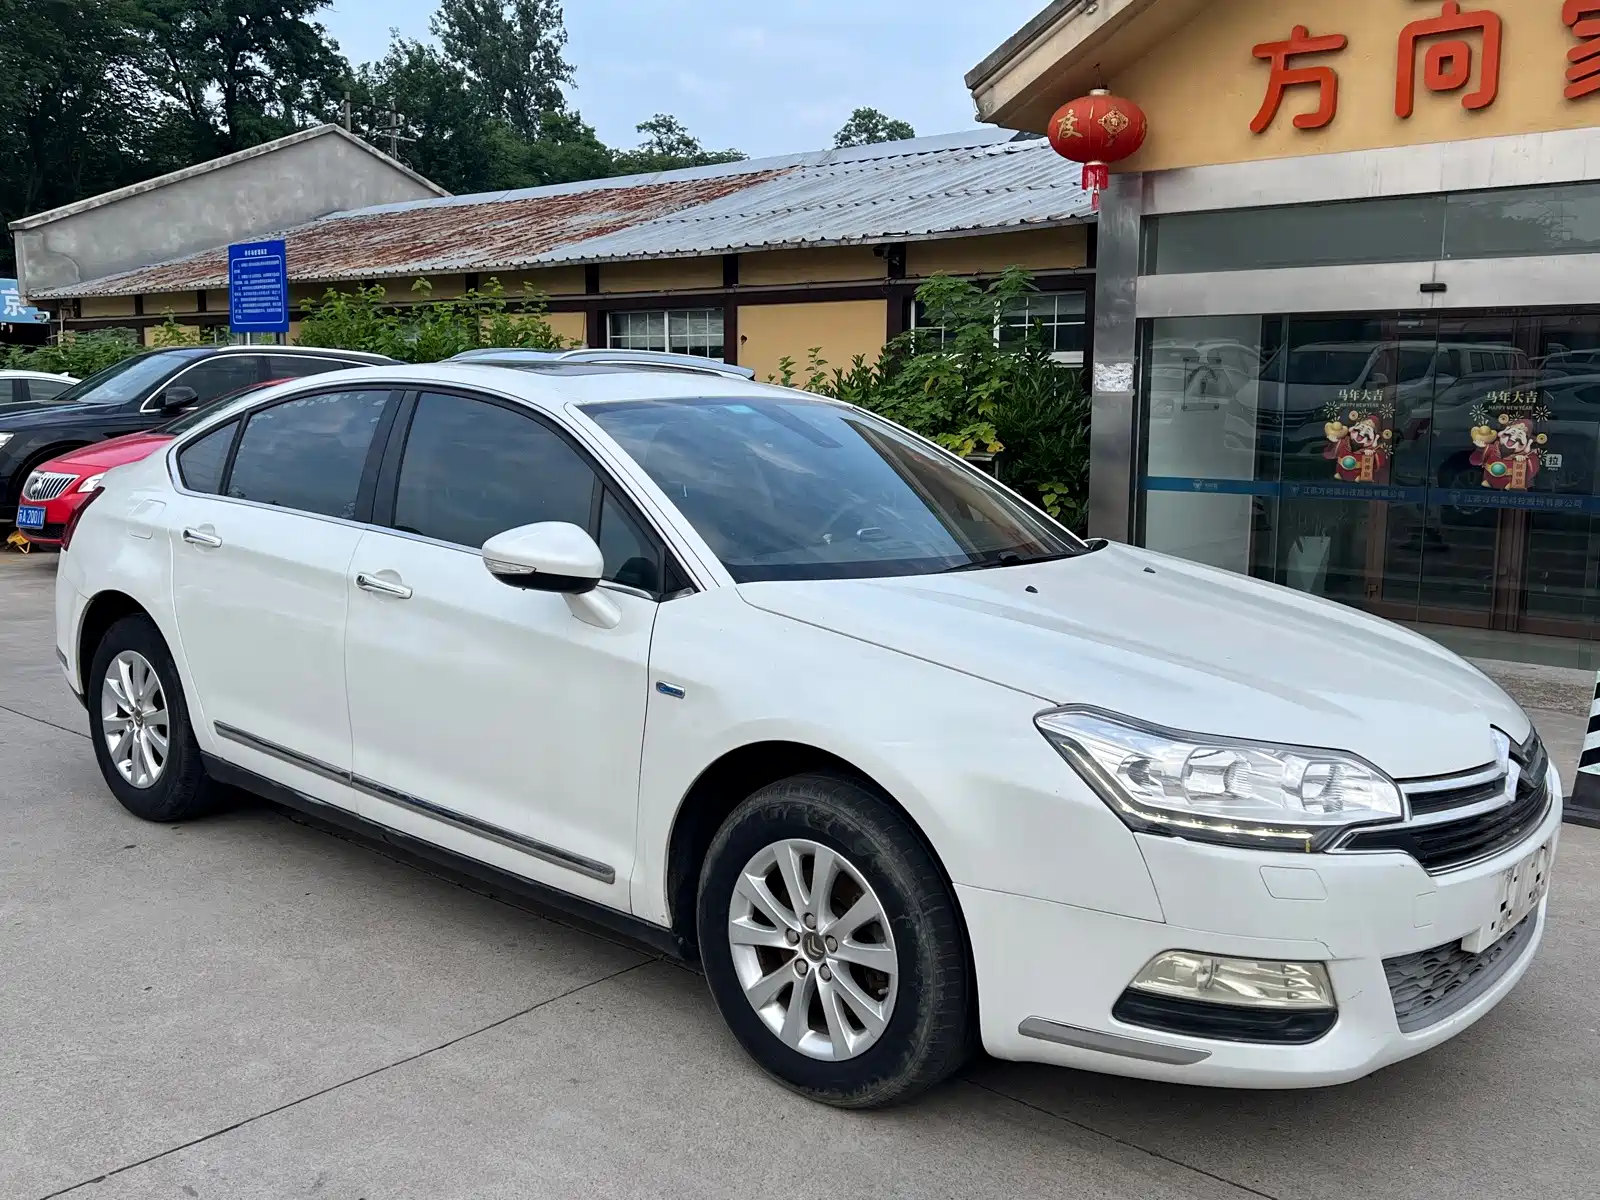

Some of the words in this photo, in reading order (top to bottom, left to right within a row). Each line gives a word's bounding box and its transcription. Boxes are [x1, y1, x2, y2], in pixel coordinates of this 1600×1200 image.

[1057, 108, 1083, 143] 度
[1, 288, 26, 316] 京
[1338, 388, 1383, 401] 马年大吉
[1485, 390, 1538, 404] 马年大吉
[1548, 455, 1559, 466] 拉
